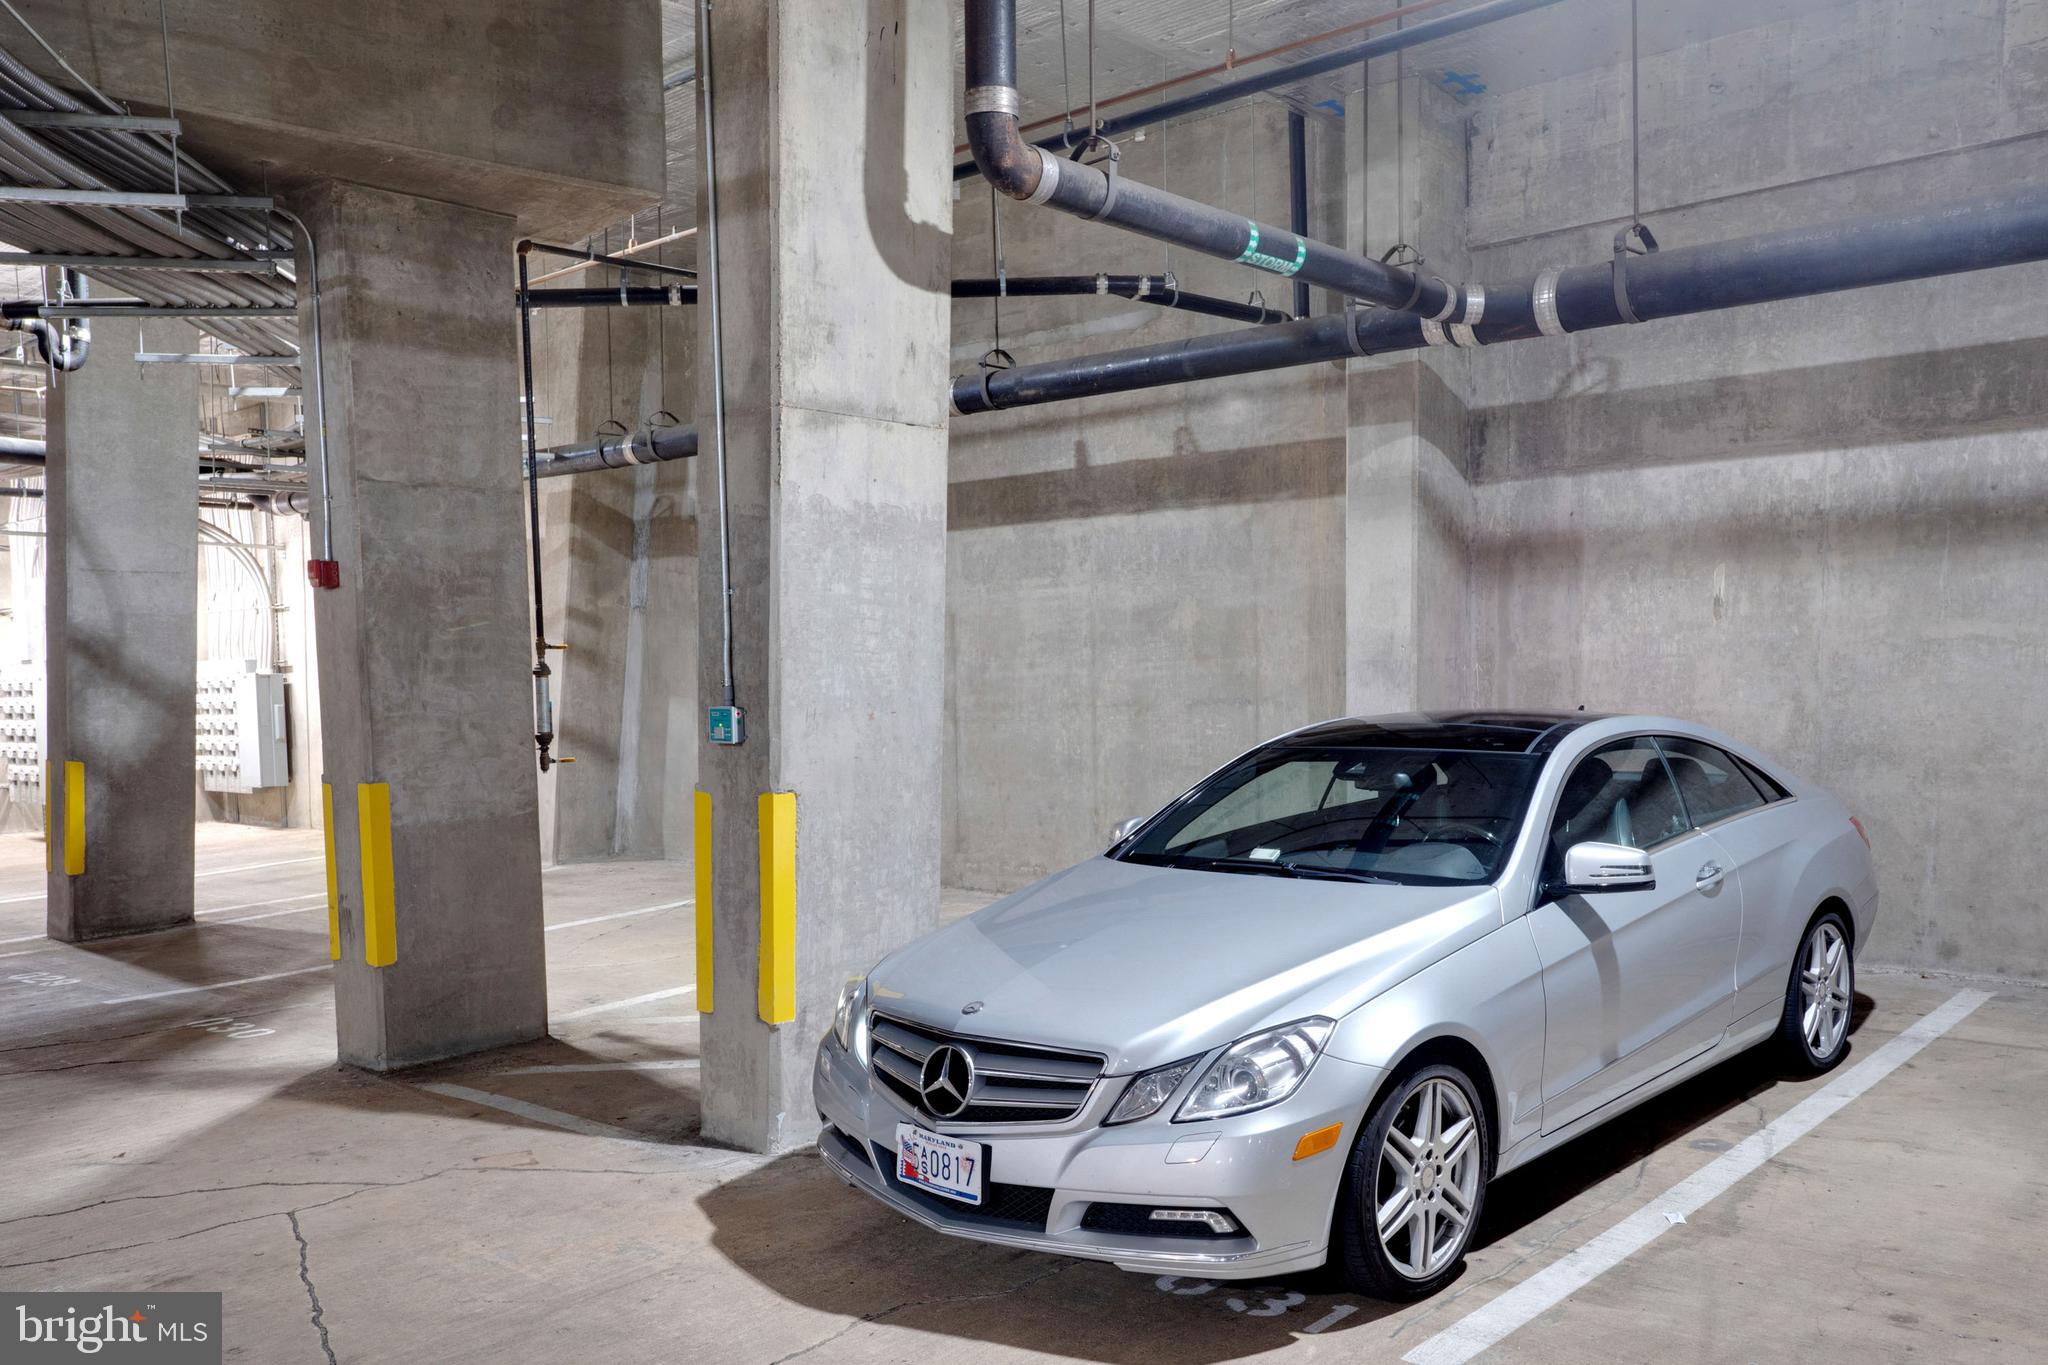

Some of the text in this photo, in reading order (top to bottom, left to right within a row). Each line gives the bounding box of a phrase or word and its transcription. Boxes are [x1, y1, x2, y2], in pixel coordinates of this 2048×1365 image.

[1249, 252, 1293, 273] STORM
[186, 1017, 276, 1039] 030
[918, 1133, 956, 1149] MARYLAND
